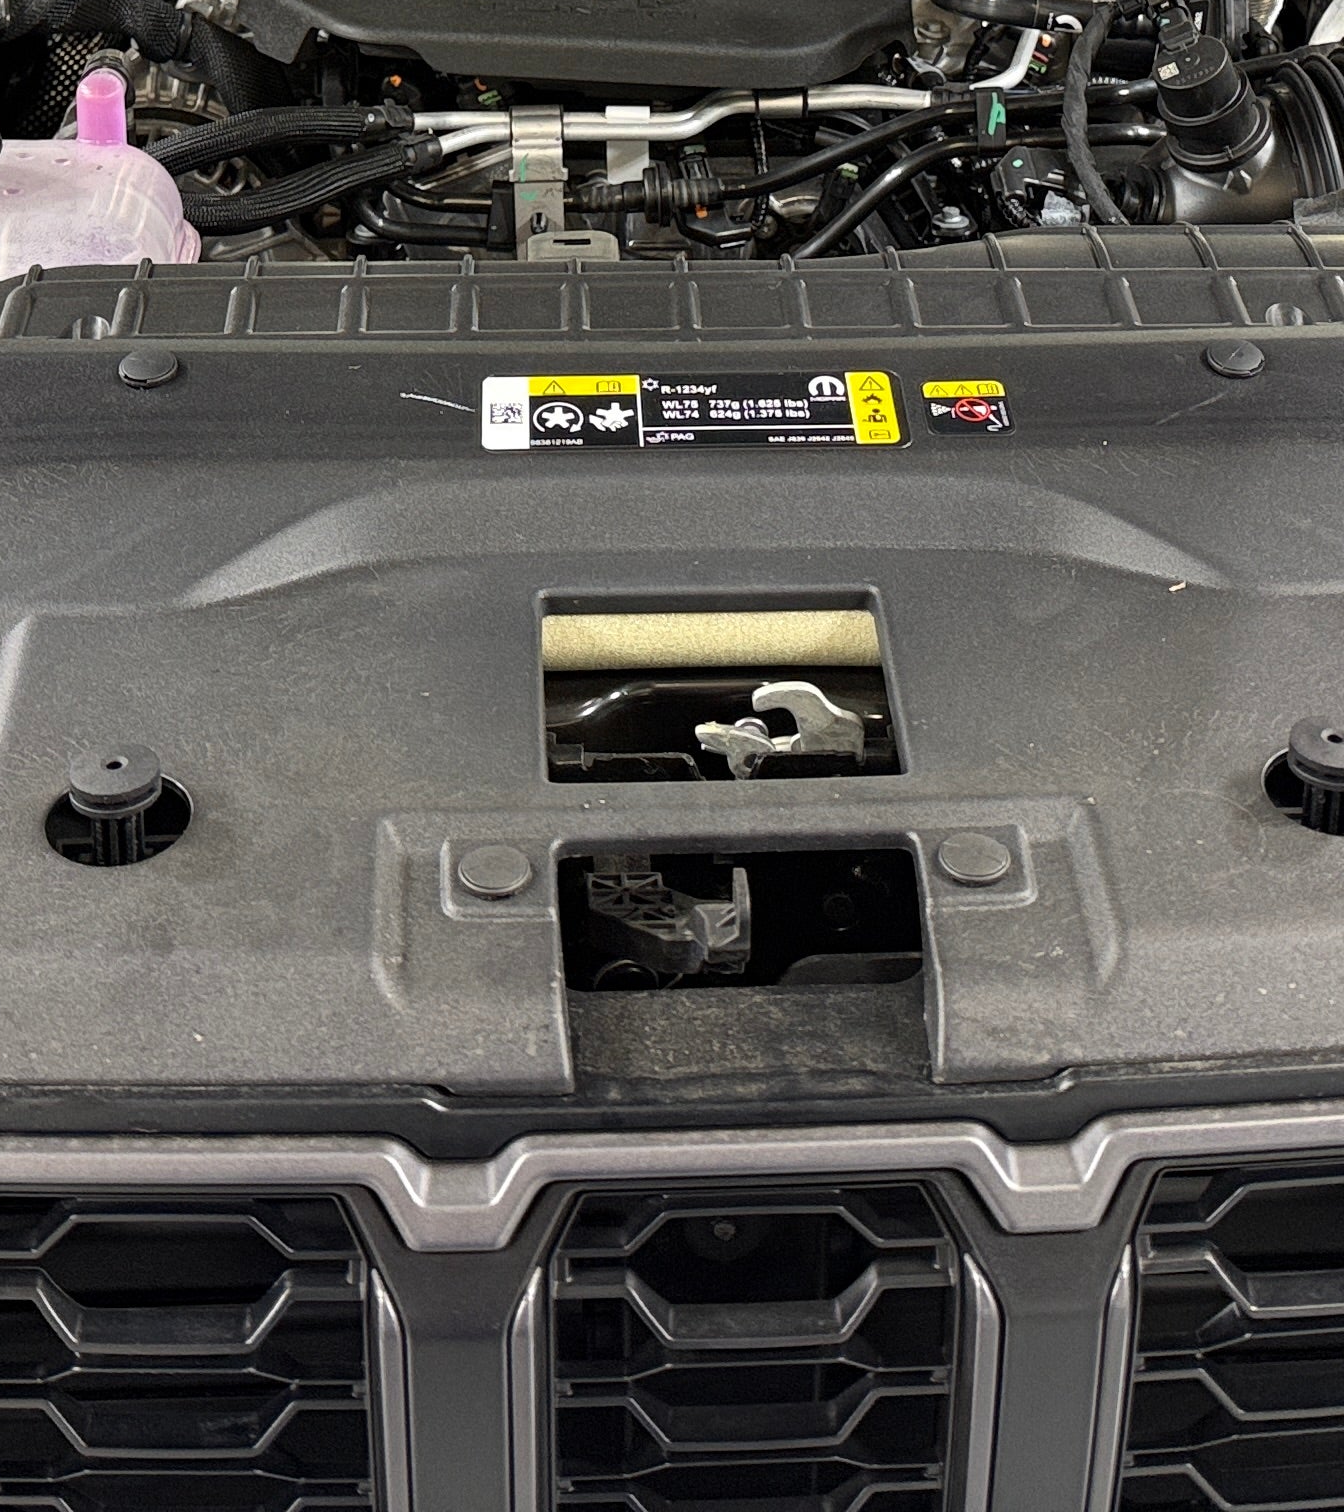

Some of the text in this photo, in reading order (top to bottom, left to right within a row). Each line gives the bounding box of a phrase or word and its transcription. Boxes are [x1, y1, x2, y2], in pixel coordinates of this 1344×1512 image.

[661, 384, 718, 396] R-1234yf
[708, 399, 740, 411] 737g
[662, 409, 700, 419] WL74
[709, 409, 741, 420] 624g
[670, 432, 695, 441] PAG
